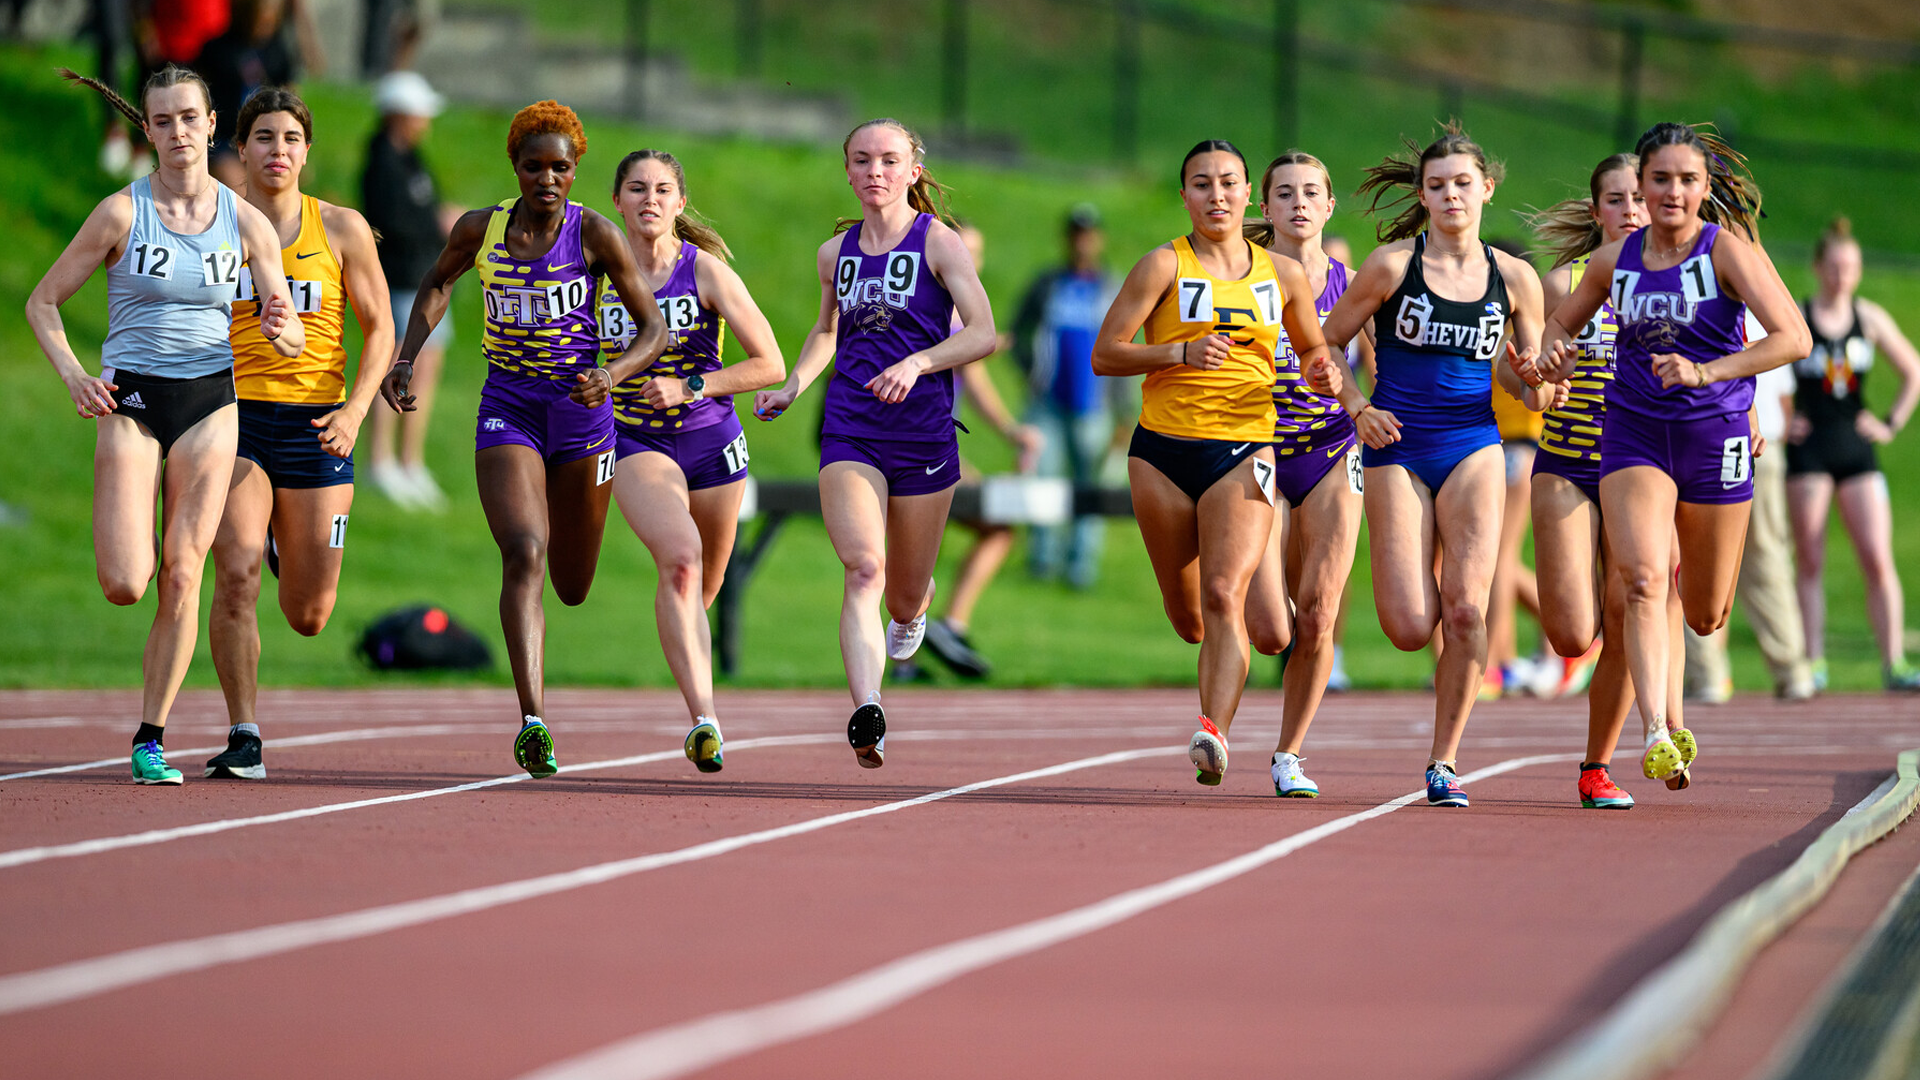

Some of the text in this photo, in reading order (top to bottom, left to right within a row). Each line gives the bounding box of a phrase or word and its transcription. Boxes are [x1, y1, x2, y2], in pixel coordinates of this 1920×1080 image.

[134, 244, 169, 277] 12
[205, 252, 236, 283] 12
[839, 259, 855, 297] 9
[889, 255, 914, 291] 9
[1616, 274, 1629, 312] 1
[1686, 261, 1706, 297] 1
[551, 282, 582, 315] 10
[661, 299, 693, 328] 13
[1183, 282, 1205, 319] 7
[1255, 284, 1275, 321] 7
[1400, 300, 1426, 340] 5
[1481, 319, 1501, 355] 5
[1257, 462, 1271, 490] 7
[1729, 441, 1742, 478] 1
